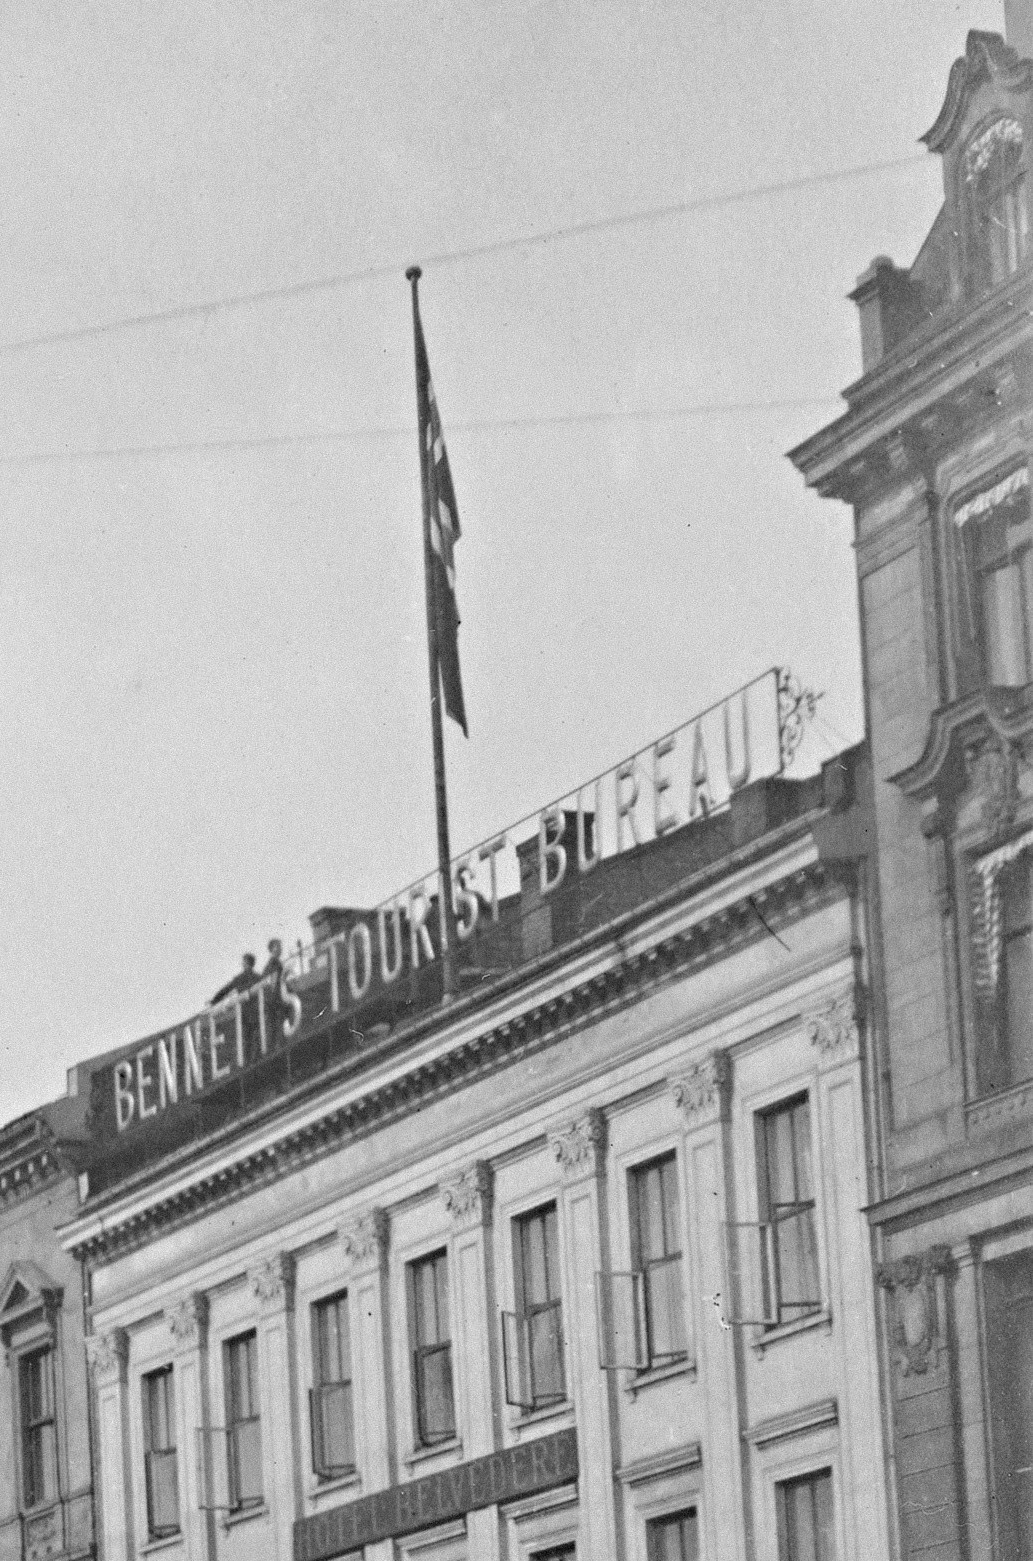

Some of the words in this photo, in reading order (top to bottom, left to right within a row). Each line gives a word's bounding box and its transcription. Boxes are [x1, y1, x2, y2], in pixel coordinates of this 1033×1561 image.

[319, 836, 507, 1013] TOURIST
[538, 688, 752, 893] BUREAU
[295, 1497, 383, 1560] HOTEL
[395, 1434, 573, 1529] BELVEDERE
